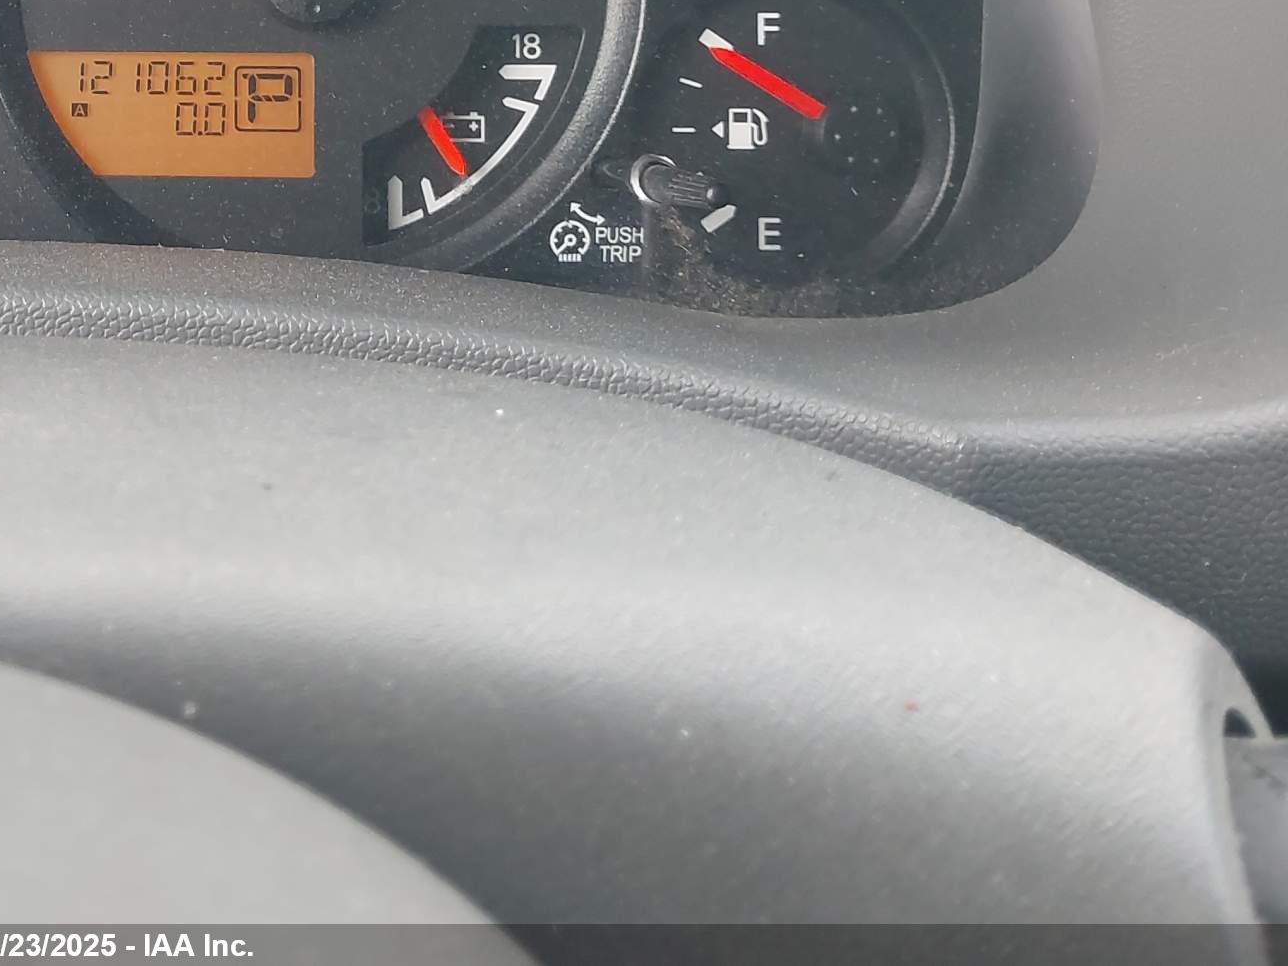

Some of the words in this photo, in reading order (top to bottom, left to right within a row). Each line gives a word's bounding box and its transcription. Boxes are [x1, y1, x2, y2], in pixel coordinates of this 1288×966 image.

[758, 13, 780, 45] F
[513, 34, 541, 59] 18
[80, 61, 226, 95] 121062
[72, 103, 88, 117] A
[242, 73, 295, 123] P
[176, 102, 226, 136] 0.0
[595, 227, 645, 244] PUSH
[758, 218, 781, 250] E
[600, 245, 642, 263] TRIP
